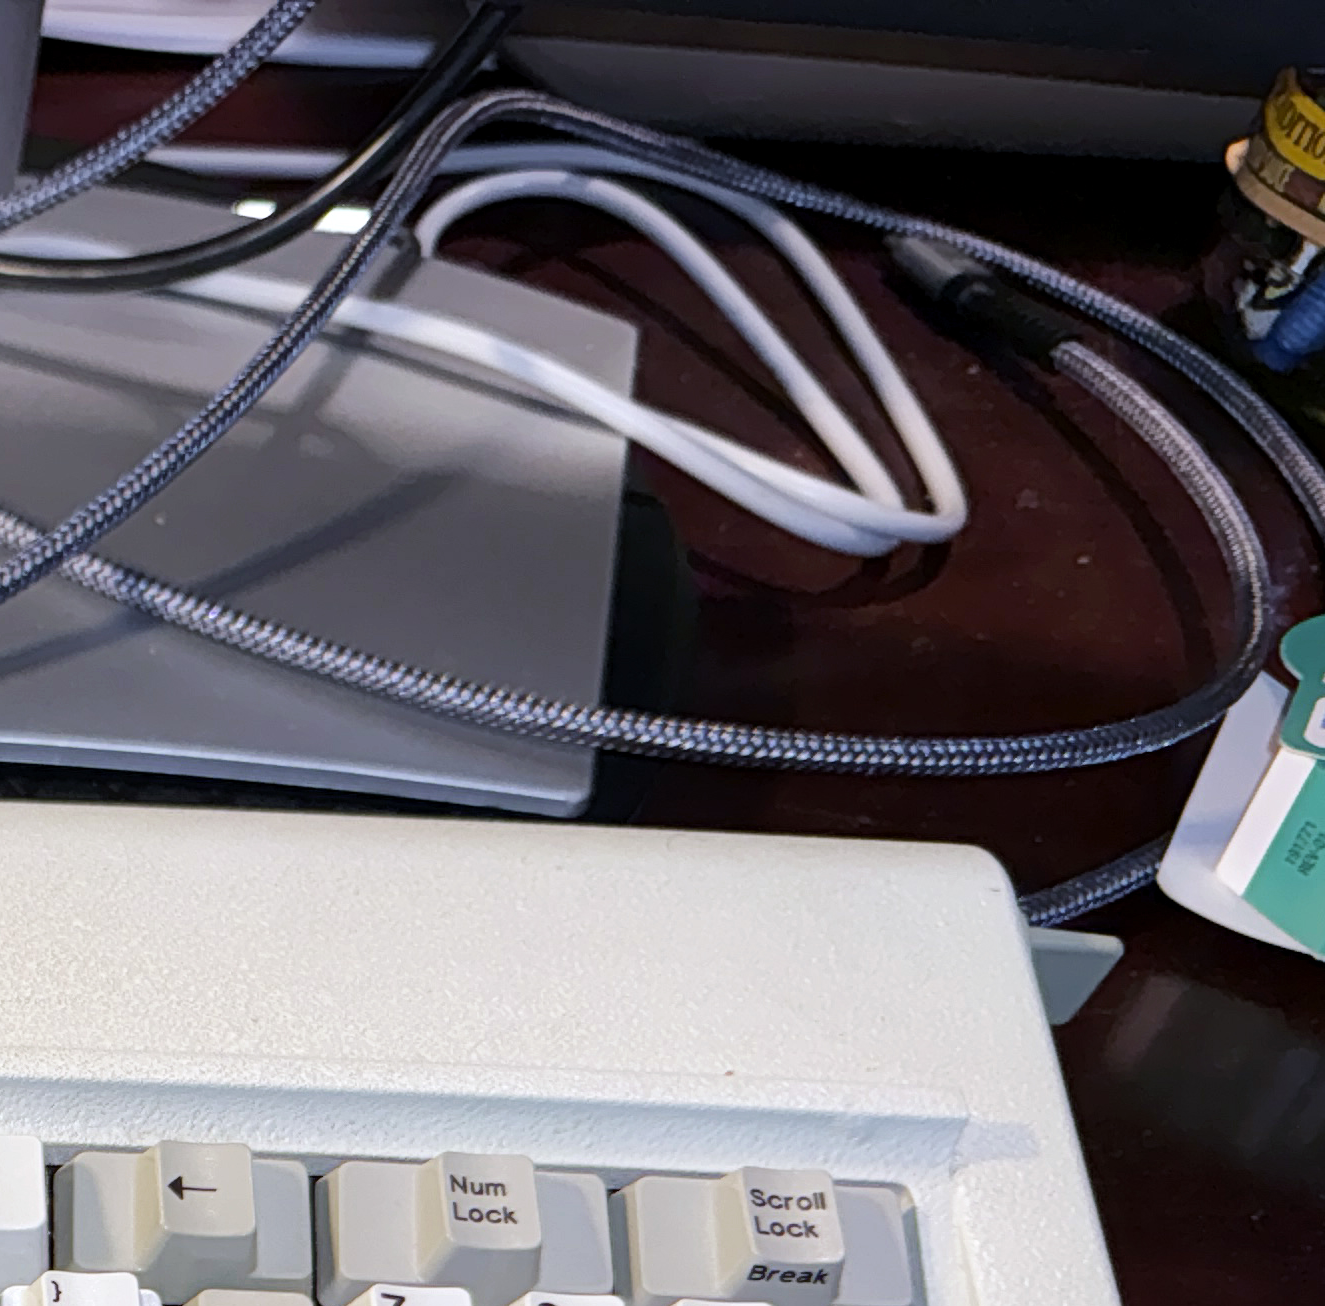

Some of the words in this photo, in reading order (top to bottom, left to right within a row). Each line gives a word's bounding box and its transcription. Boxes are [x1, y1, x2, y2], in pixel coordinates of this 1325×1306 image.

[450, 1174, 507, 1196] Num
[750, 1189, 826, 1211] Scroll
[453, 1202, 517, 1224] Lock
[754, 1216, 819, 1238] Lock
[748, 1263, 828, 1285] Break
